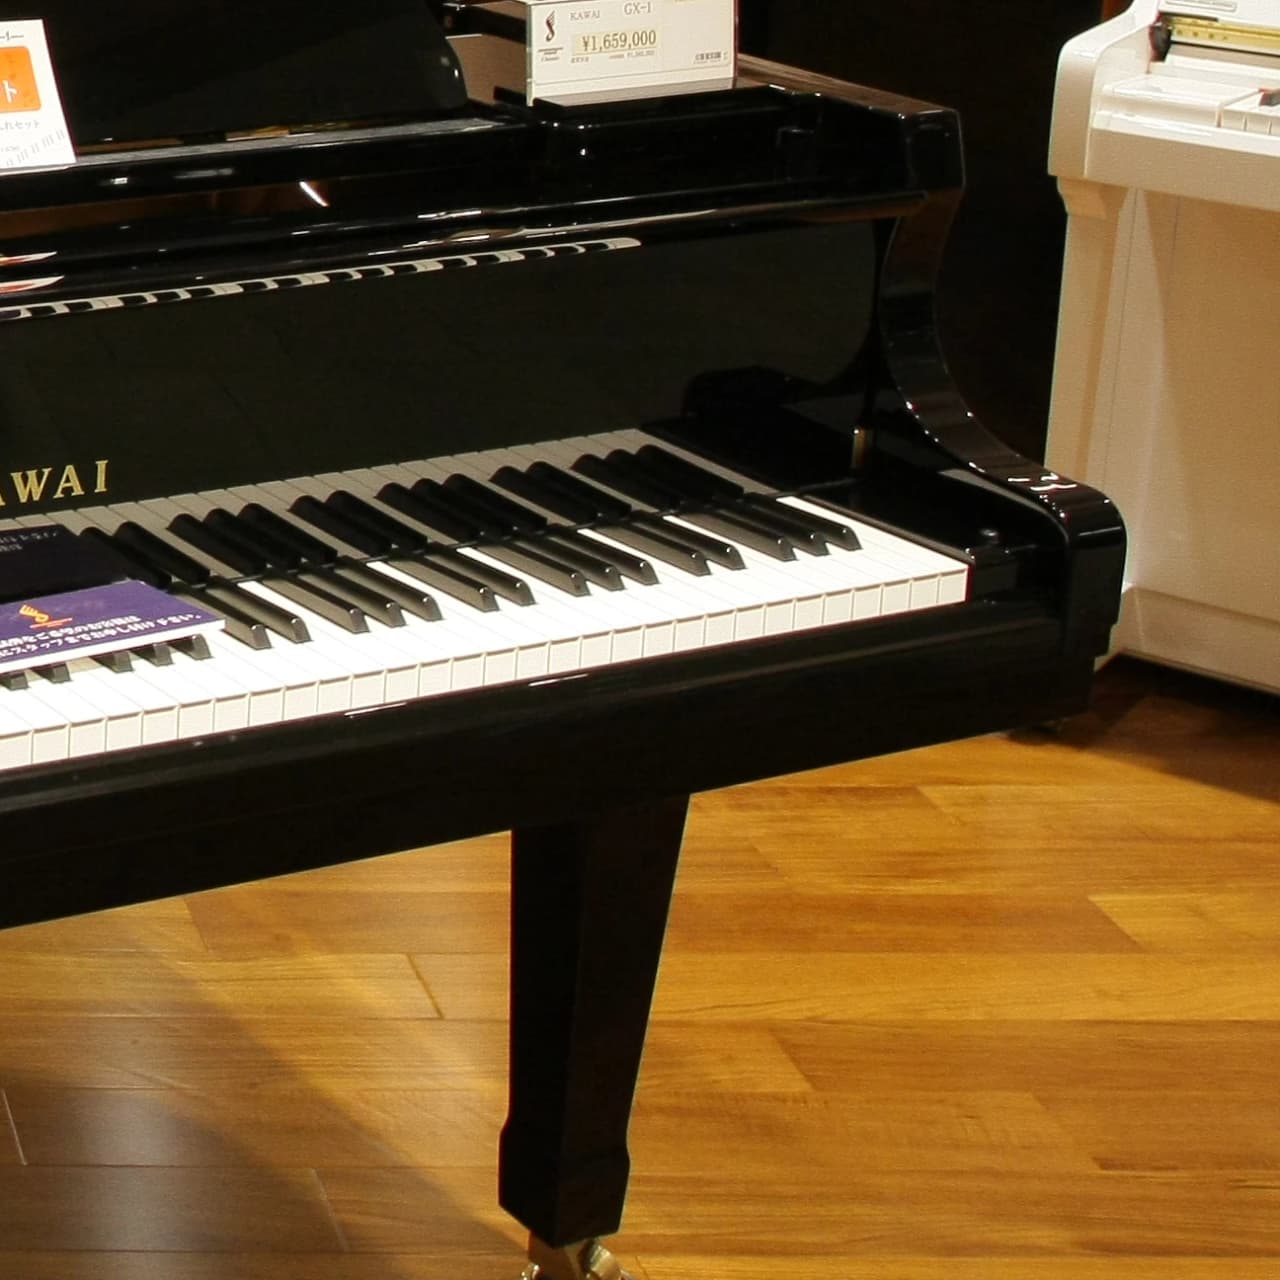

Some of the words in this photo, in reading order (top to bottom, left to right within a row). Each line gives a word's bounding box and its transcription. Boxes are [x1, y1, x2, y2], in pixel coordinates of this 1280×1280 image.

[569, 9, 601, 22] KAWAI
[623, 1, 652, 16] GX-1
[581, 29, 657, 53] ¥1,659,000
